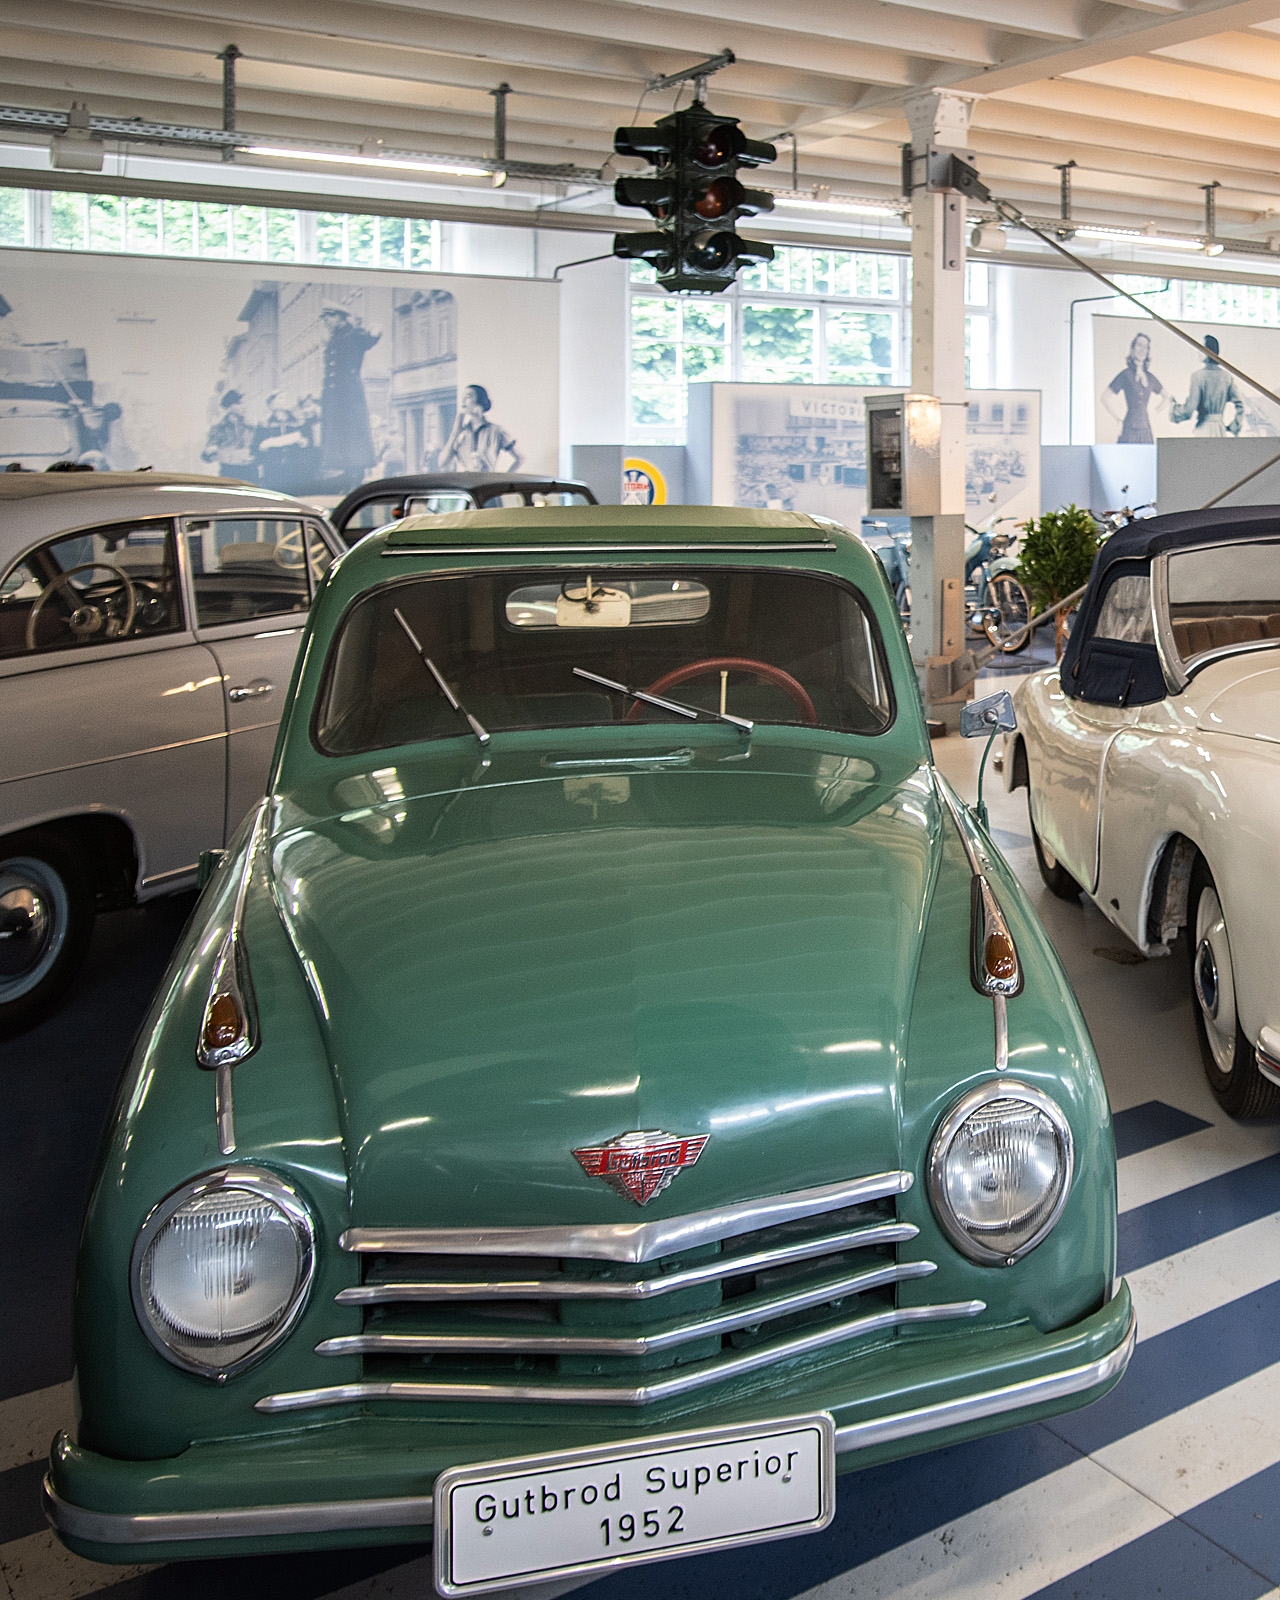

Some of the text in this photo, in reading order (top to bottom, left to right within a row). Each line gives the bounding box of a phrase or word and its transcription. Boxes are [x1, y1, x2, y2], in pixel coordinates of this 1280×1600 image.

[475, 1449, 799, 1523] Gutbrod Superior
[599, 1505, 685, 1547] 1952
